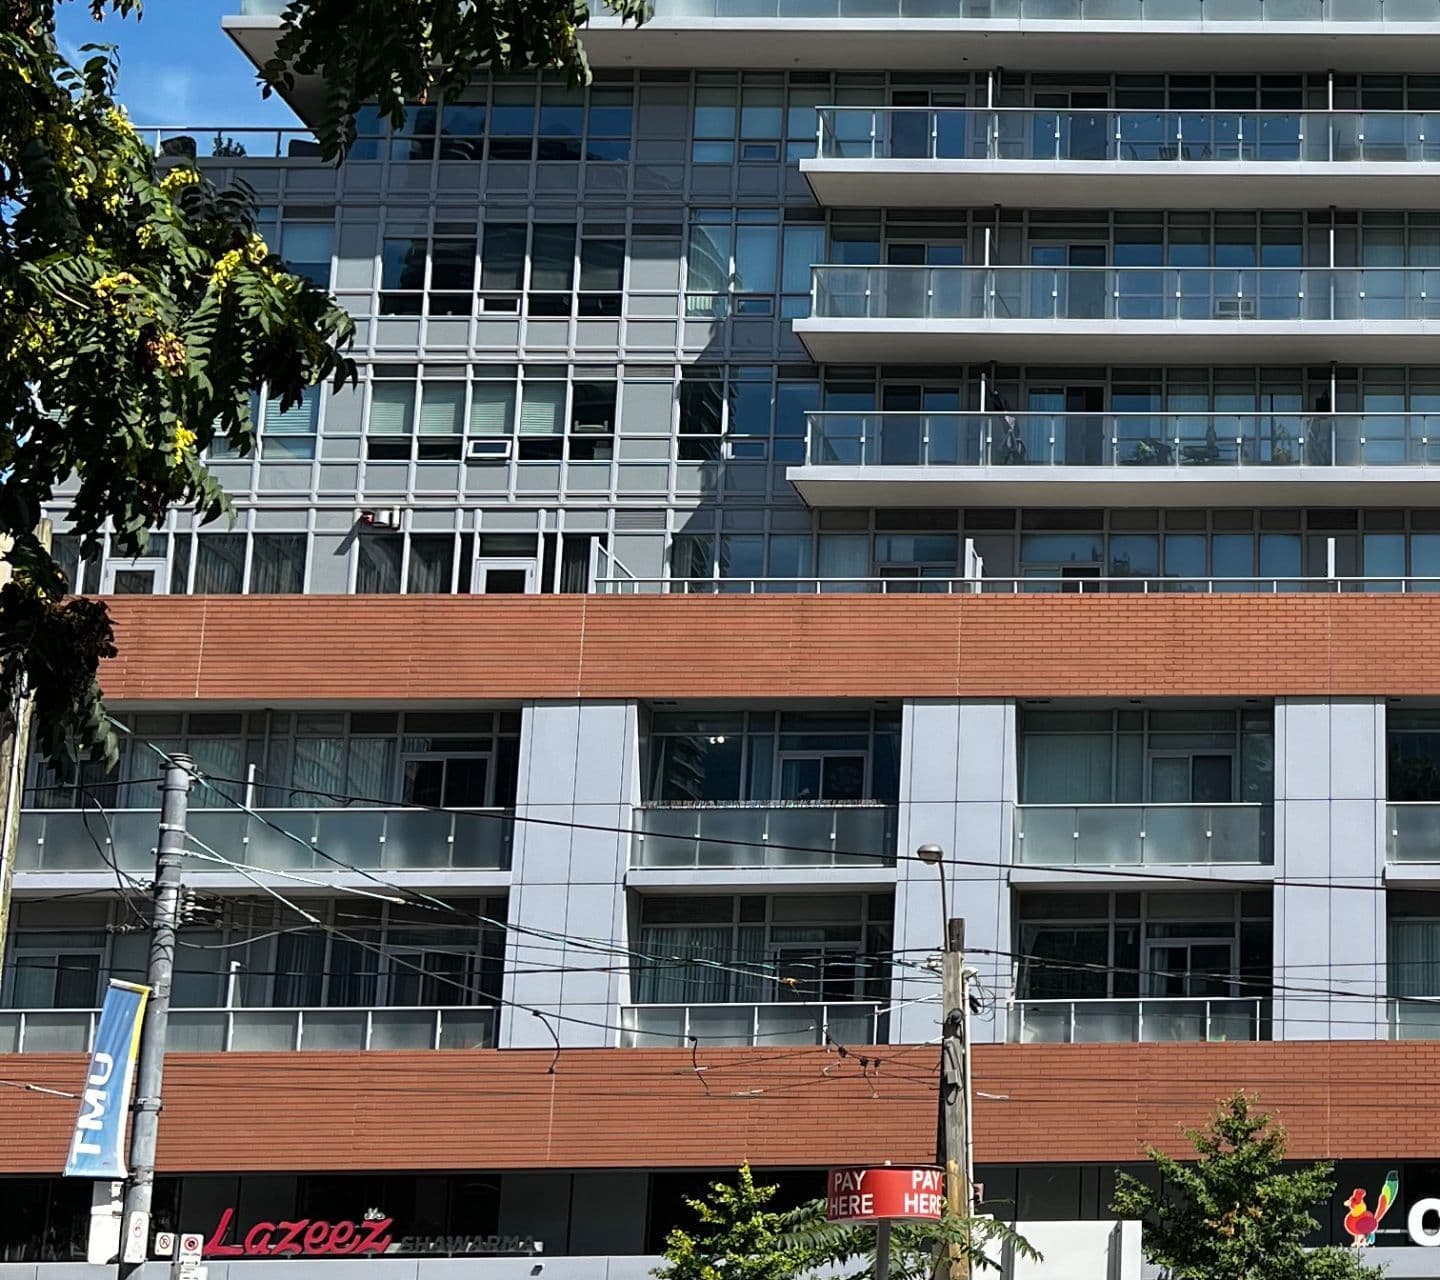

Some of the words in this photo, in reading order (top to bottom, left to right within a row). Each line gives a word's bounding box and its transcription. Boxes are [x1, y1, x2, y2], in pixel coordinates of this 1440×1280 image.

[71, 1051, 114, 1165] TMU
[834, 1170, 866, 1193] PAY
[911, 1170, 940, 1190] PAY
[830, 1193, 874, 1216] HERE
[904, 1193, 942, 1215] HERE
[202, 1207, 394, 1255] Lazeez
[400, 1235, 535, 1252] SHAWARMA
